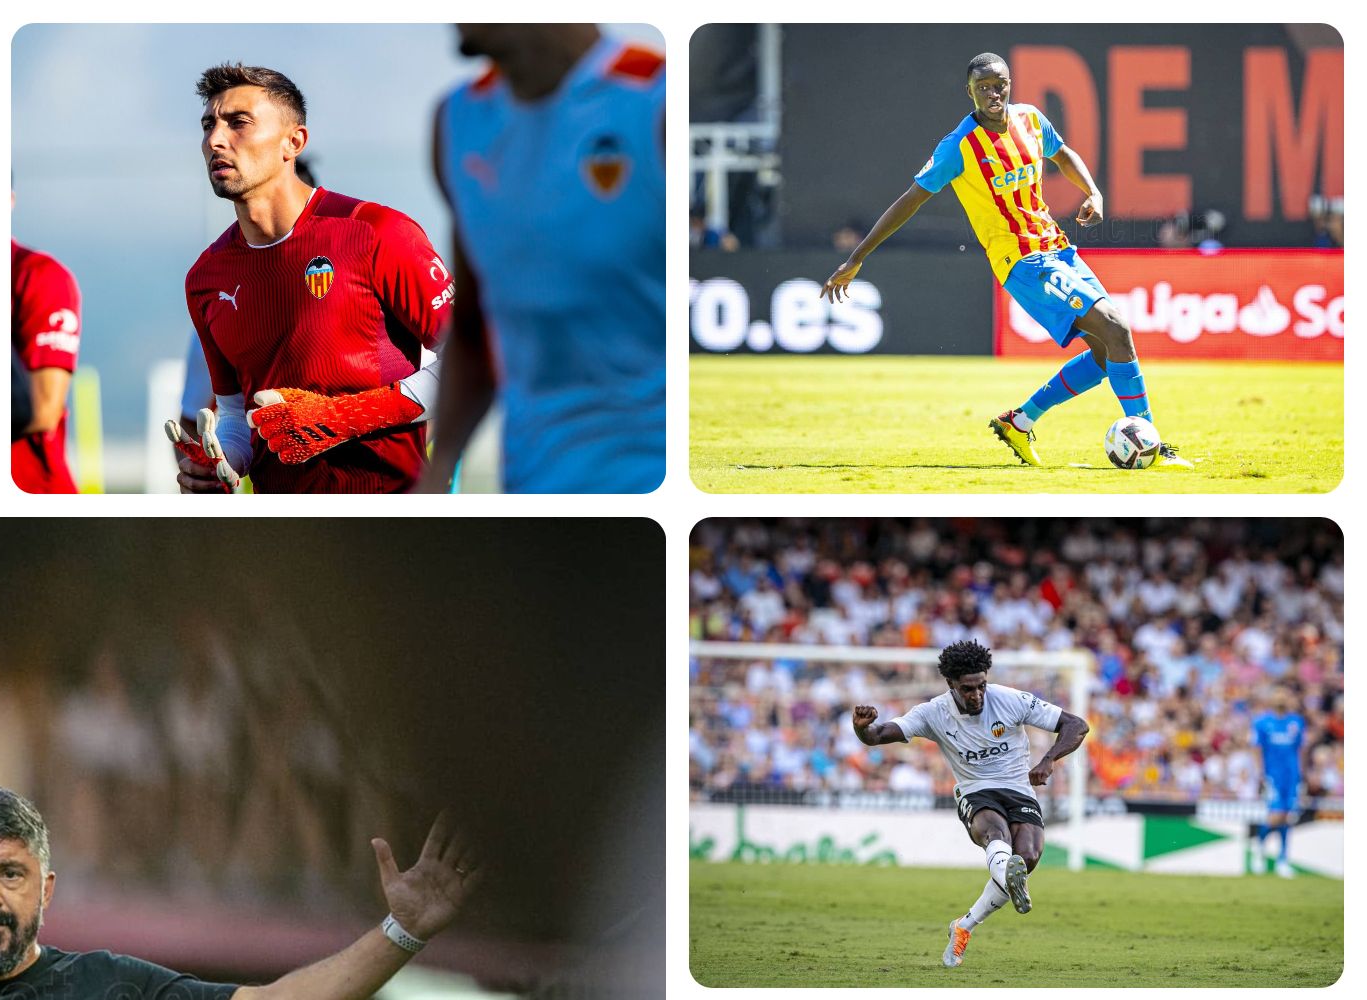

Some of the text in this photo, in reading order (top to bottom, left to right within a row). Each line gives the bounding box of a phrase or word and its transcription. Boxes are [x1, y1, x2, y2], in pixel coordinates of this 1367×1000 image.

[1010, 45, 1192, 221] DE
[993, 163, 1043, 188] CAZO
[1044, 270, 1076, 302] 12
[1104, 282, 1239, 342] aLiga
